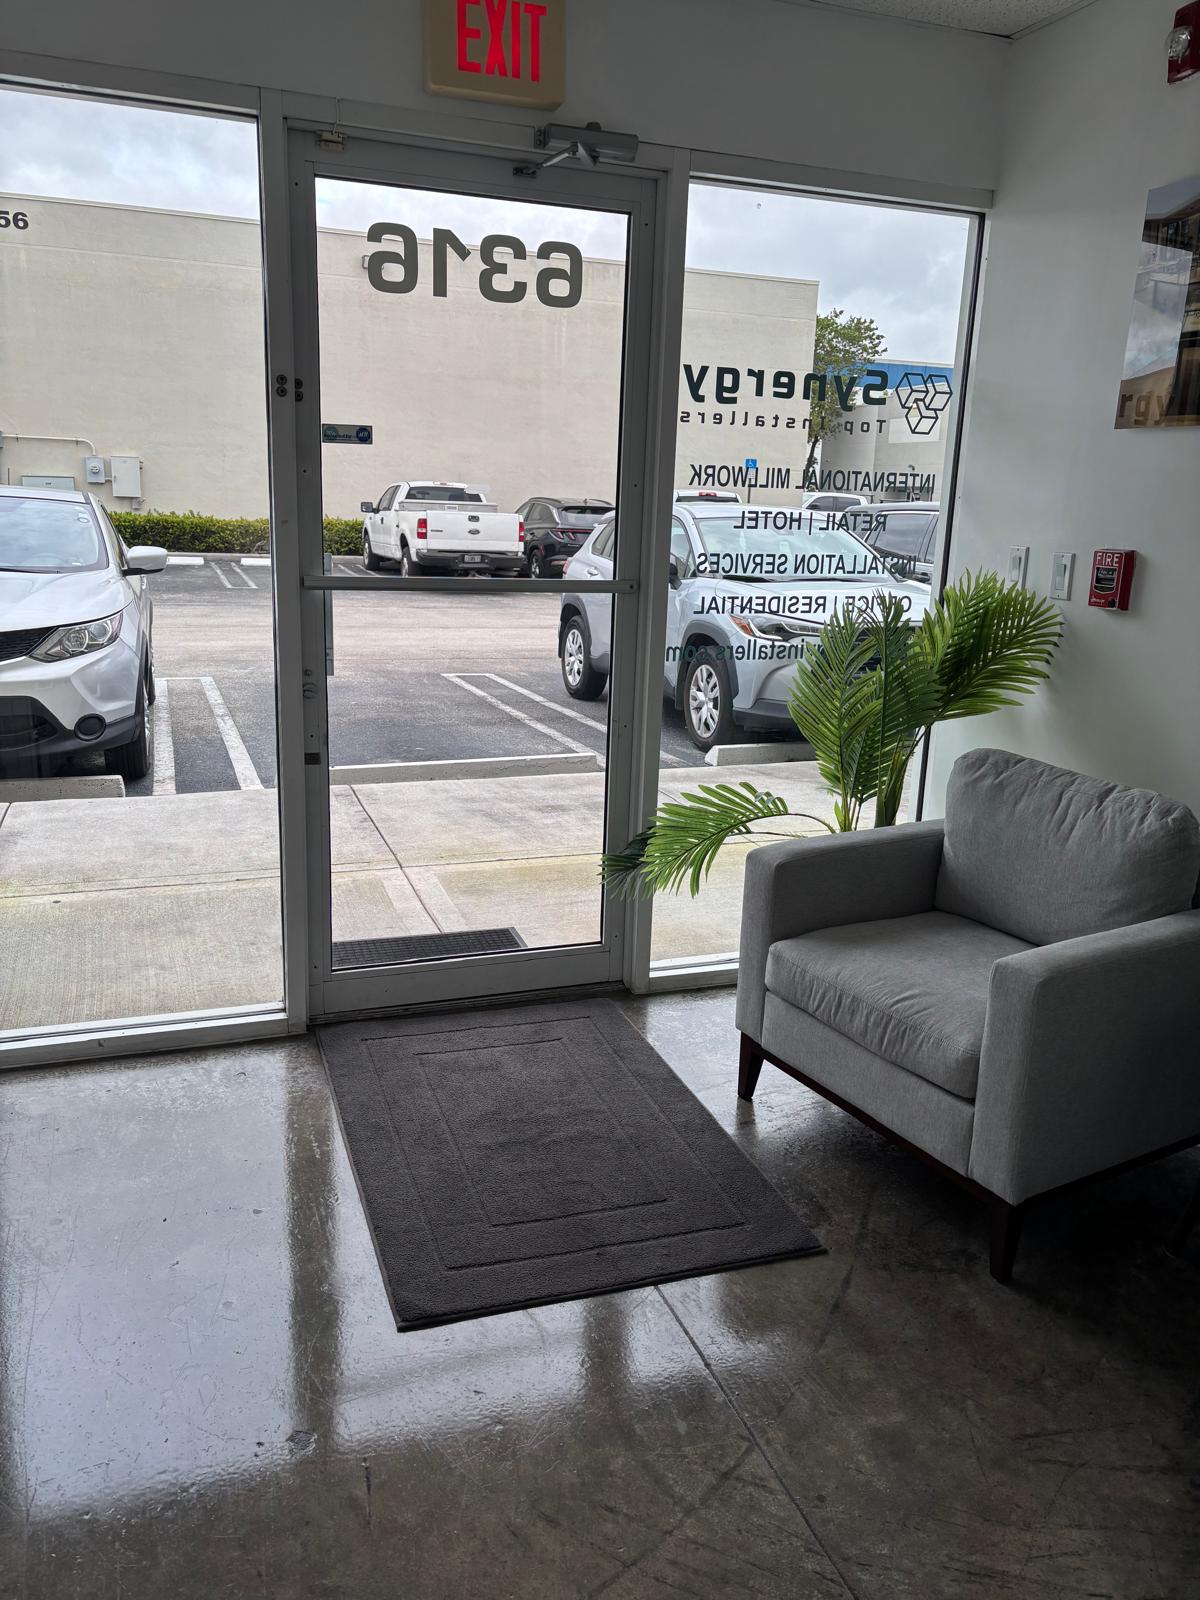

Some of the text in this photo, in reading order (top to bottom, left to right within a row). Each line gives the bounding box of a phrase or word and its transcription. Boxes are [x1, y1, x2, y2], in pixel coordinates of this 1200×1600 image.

[457, 0, 548, 84] EXIT
[0, 210, 29, 230] 56
[1095, 552, 1121, 567] FIRE
